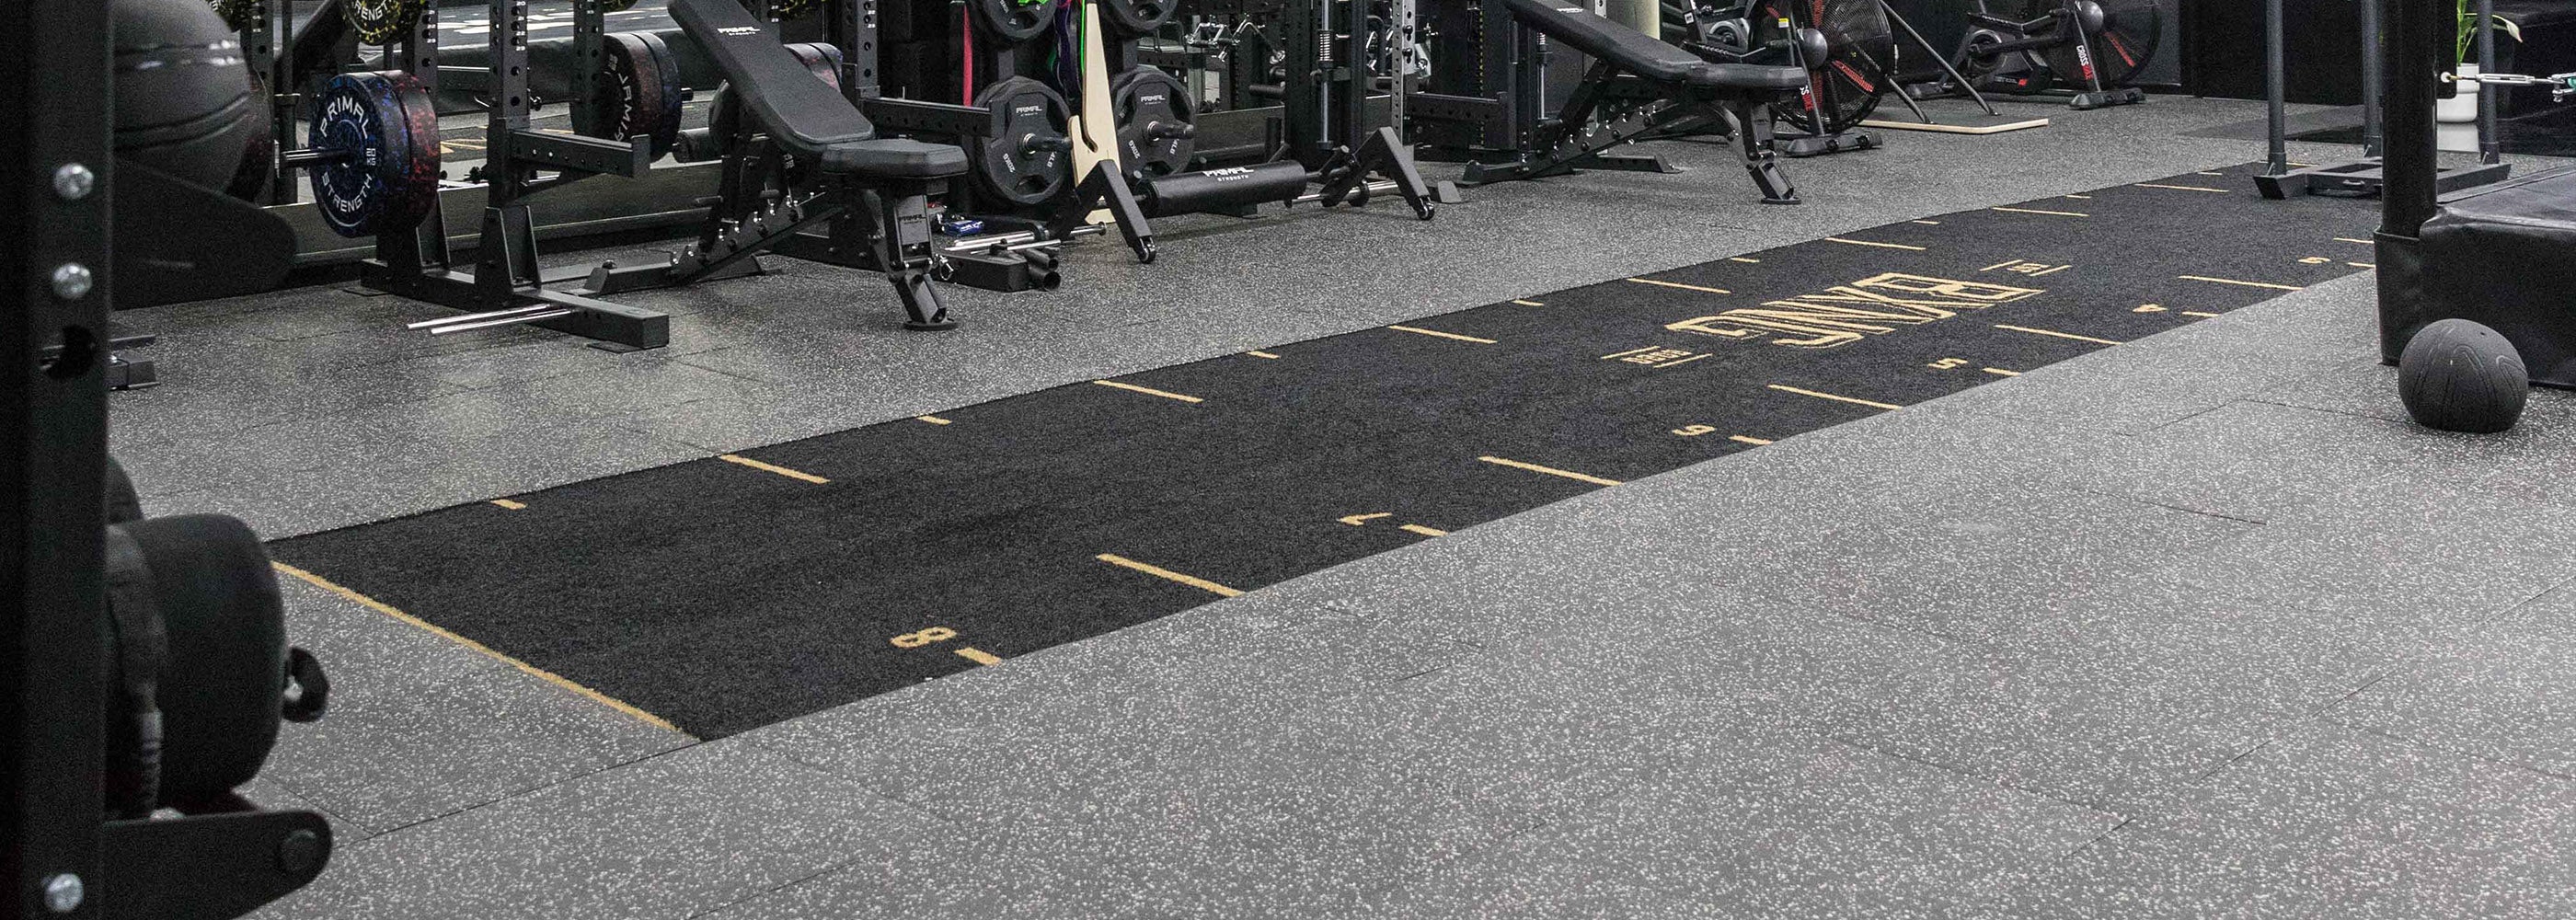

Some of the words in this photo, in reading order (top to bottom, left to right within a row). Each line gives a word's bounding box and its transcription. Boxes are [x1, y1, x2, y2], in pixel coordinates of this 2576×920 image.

[354, 0, 390, 20] RENGT
[319, 95, 369, 139] PRIMAL
[366, 147, 376, 156] 20
[366, 157, 376, 166] KG
[322, 172, 373, 213] STRENGTH
[1927, 357, 1969, 371] 5
[1672, 424, 1717, 436] 6
[1337, 512, 1392, 525] 7
[891, 627, 957, 648] 8
